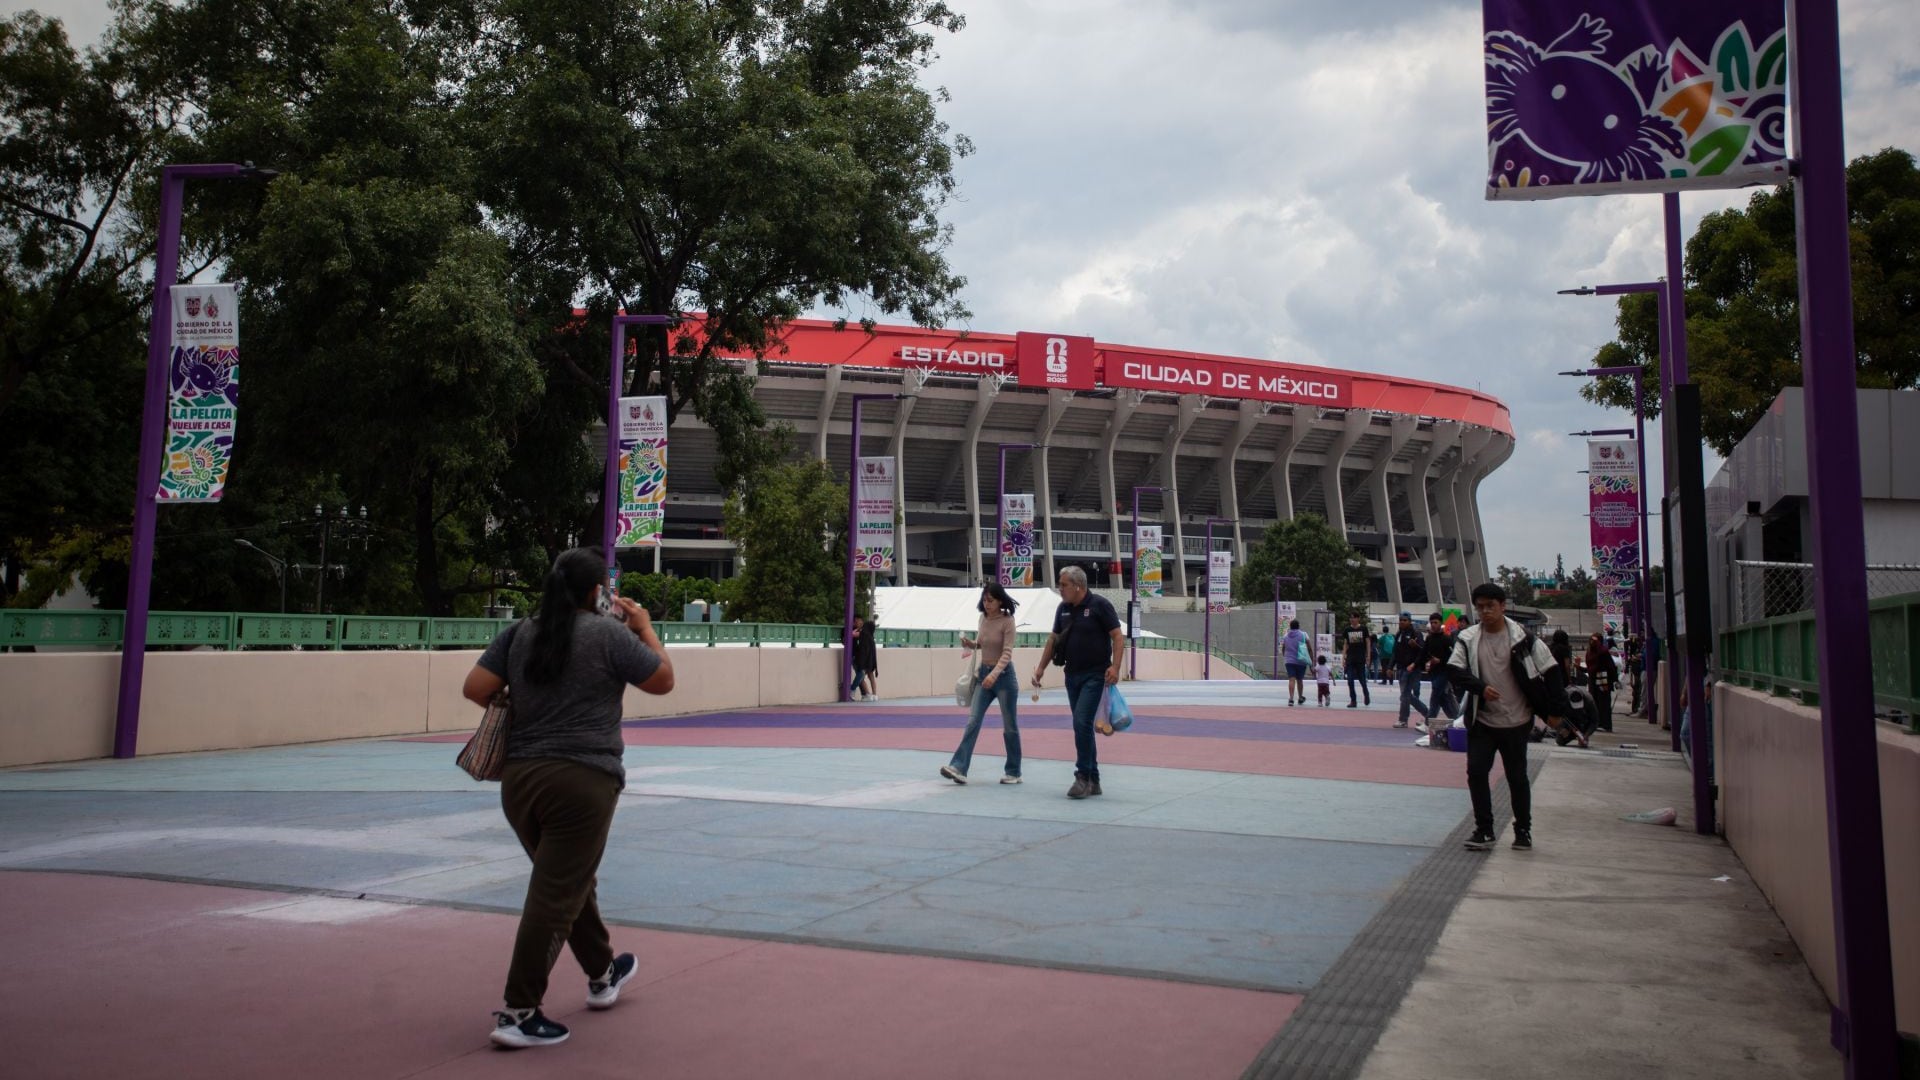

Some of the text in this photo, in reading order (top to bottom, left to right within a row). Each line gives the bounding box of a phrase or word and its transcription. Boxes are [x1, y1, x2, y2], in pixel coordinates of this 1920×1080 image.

[901, 345, 1005, 368] ESTADIO
[1123, 362, 1338, 399] CIUDAD DE MÉXICO
[172, 408, 232, 420] LA PELOTA
[172, 421, 231, 430] VUELVE A CASA
